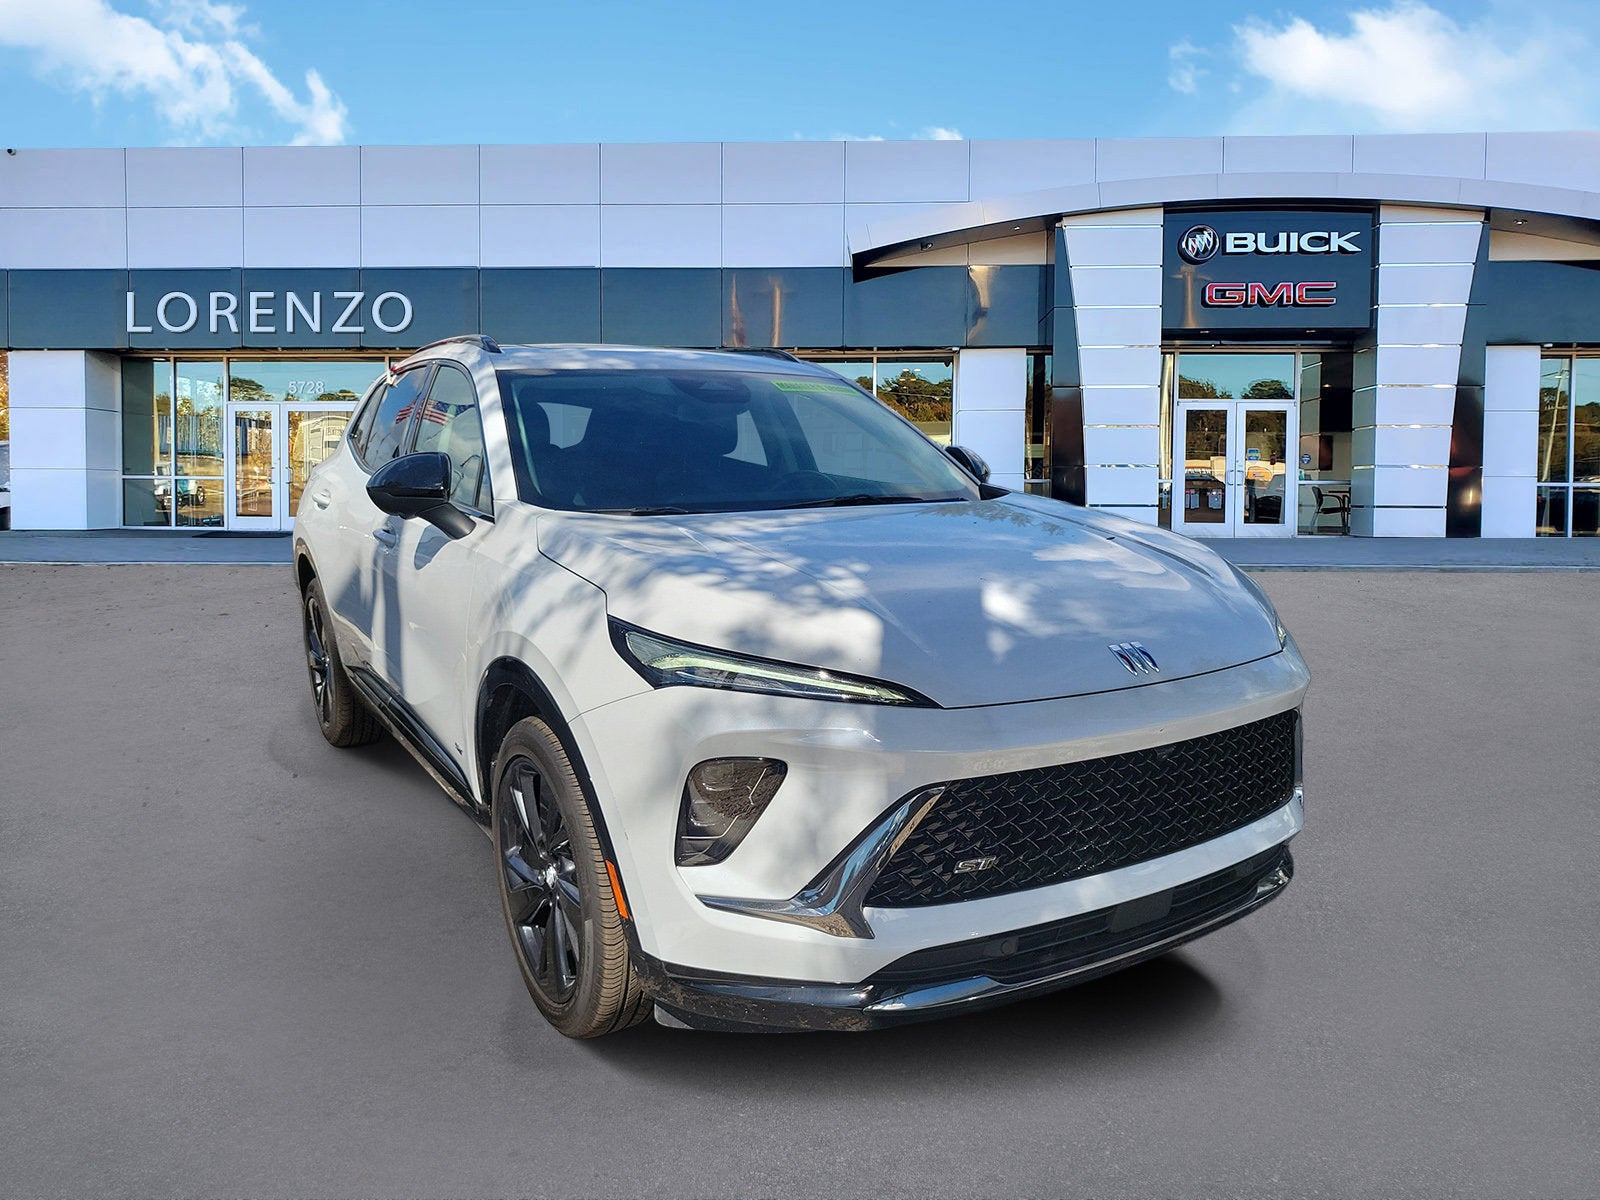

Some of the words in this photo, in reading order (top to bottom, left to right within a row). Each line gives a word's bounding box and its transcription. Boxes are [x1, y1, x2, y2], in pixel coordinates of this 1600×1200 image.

[1226, 231, 1361, 253] BUICK
[1205, 281, 1337, 305] GMC
[126, 291, 413, 334] LORENZO
[288, 380, 325, 395] 5728
